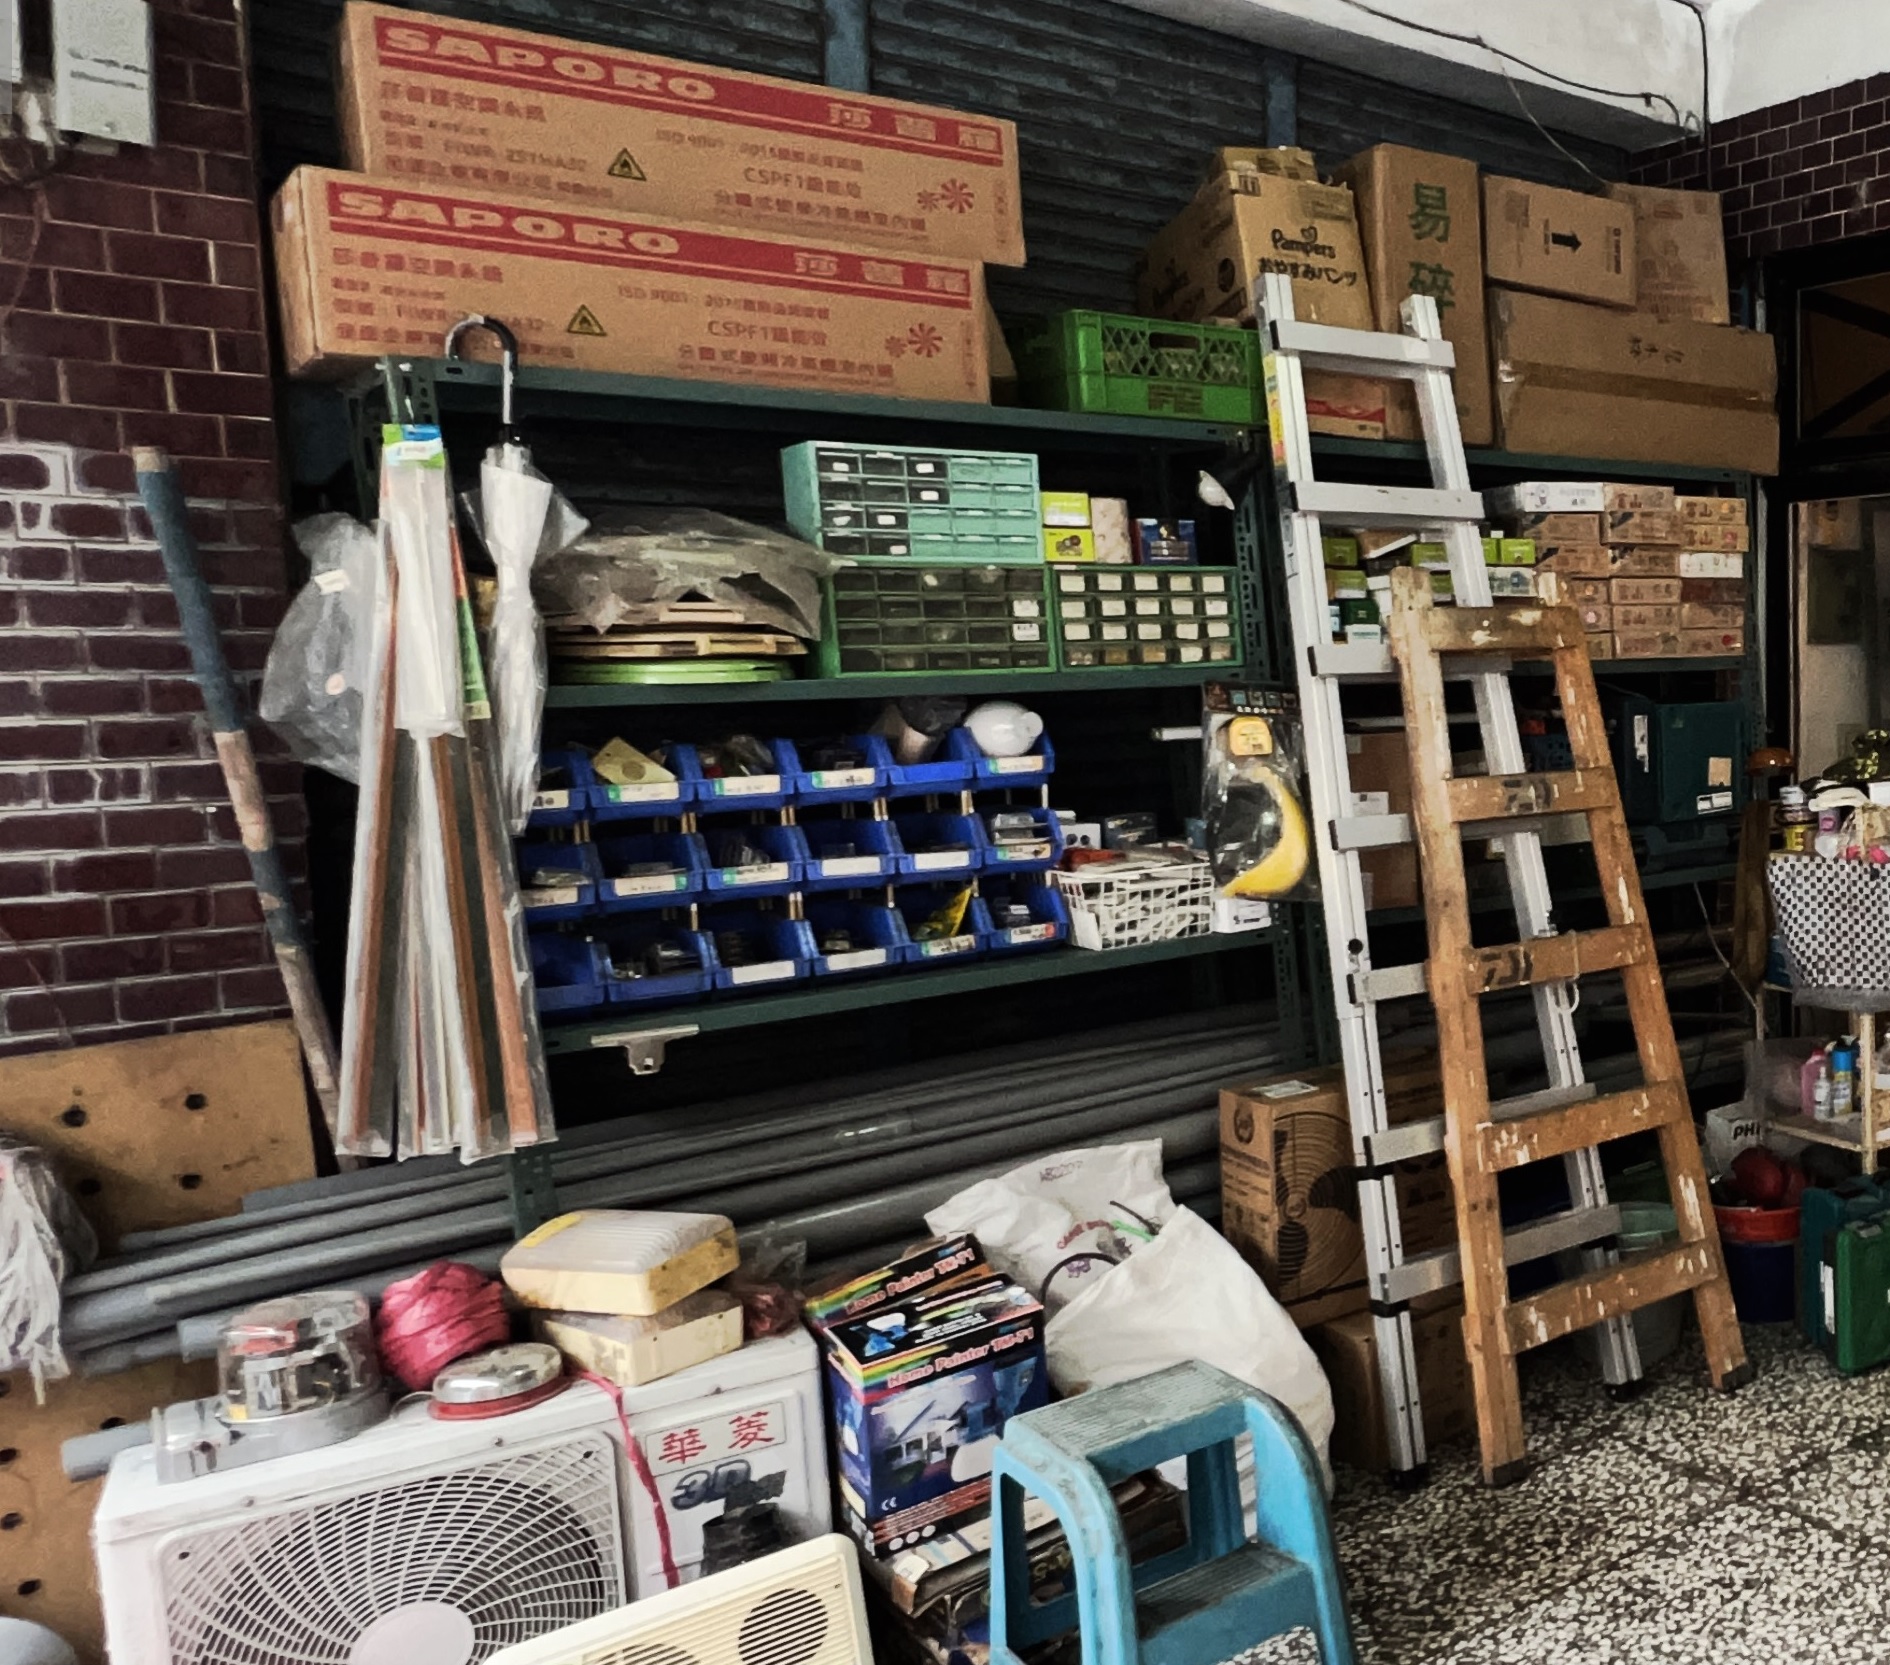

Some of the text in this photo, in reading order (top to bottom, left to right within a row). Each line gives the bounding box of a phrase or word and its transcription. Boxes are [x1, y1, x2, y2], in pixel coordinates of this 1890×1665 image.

[385, 26, 716, 100] SAPORO
[338, 191, 680, 255] SAPORO
[1271, 226, 1336, 259] Pampers
[887, 1267, 935, 1295] Painter
[887, 1362, 935, 1389] Home
[935, 1343, 990, 1373] Painter
[658, 1411, 775, 1465] 華菱
